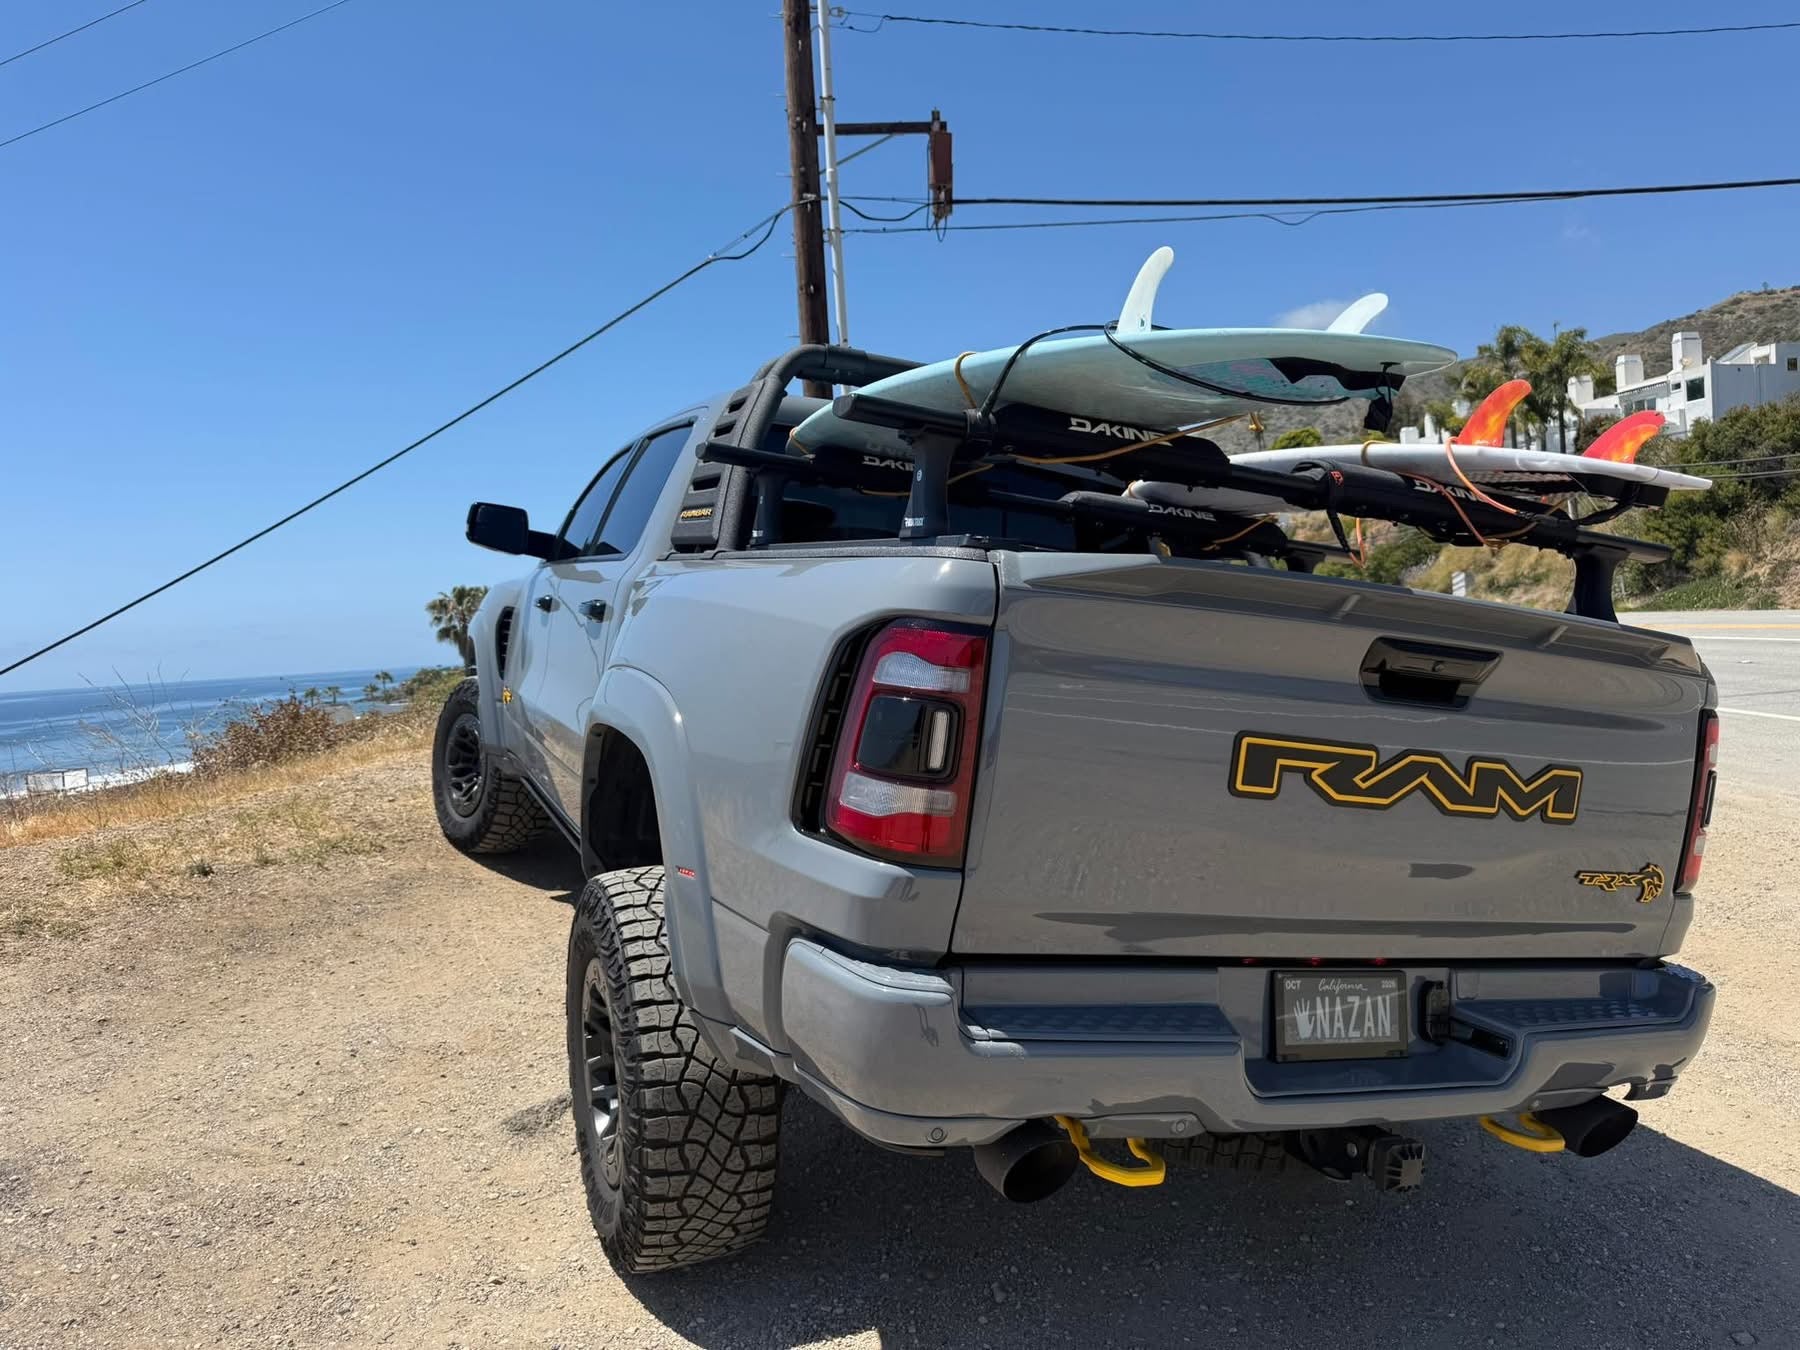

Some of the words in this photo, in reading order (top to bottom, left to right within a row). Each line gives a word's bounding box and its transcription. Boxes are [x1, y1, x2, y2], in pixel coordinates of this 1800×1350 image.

[862, 455, 914, 471] DAKI
[1148, 503, 1217, 522] DAKINE
[1229, 730, 1583, 825] RAM
[1576, 871, 1640, 891] TRX
[1285, 980, 1301, 990] OCT
[1318, 978, 1368, 994] California
[1316, 995, 1391, 1039] NAZAN
